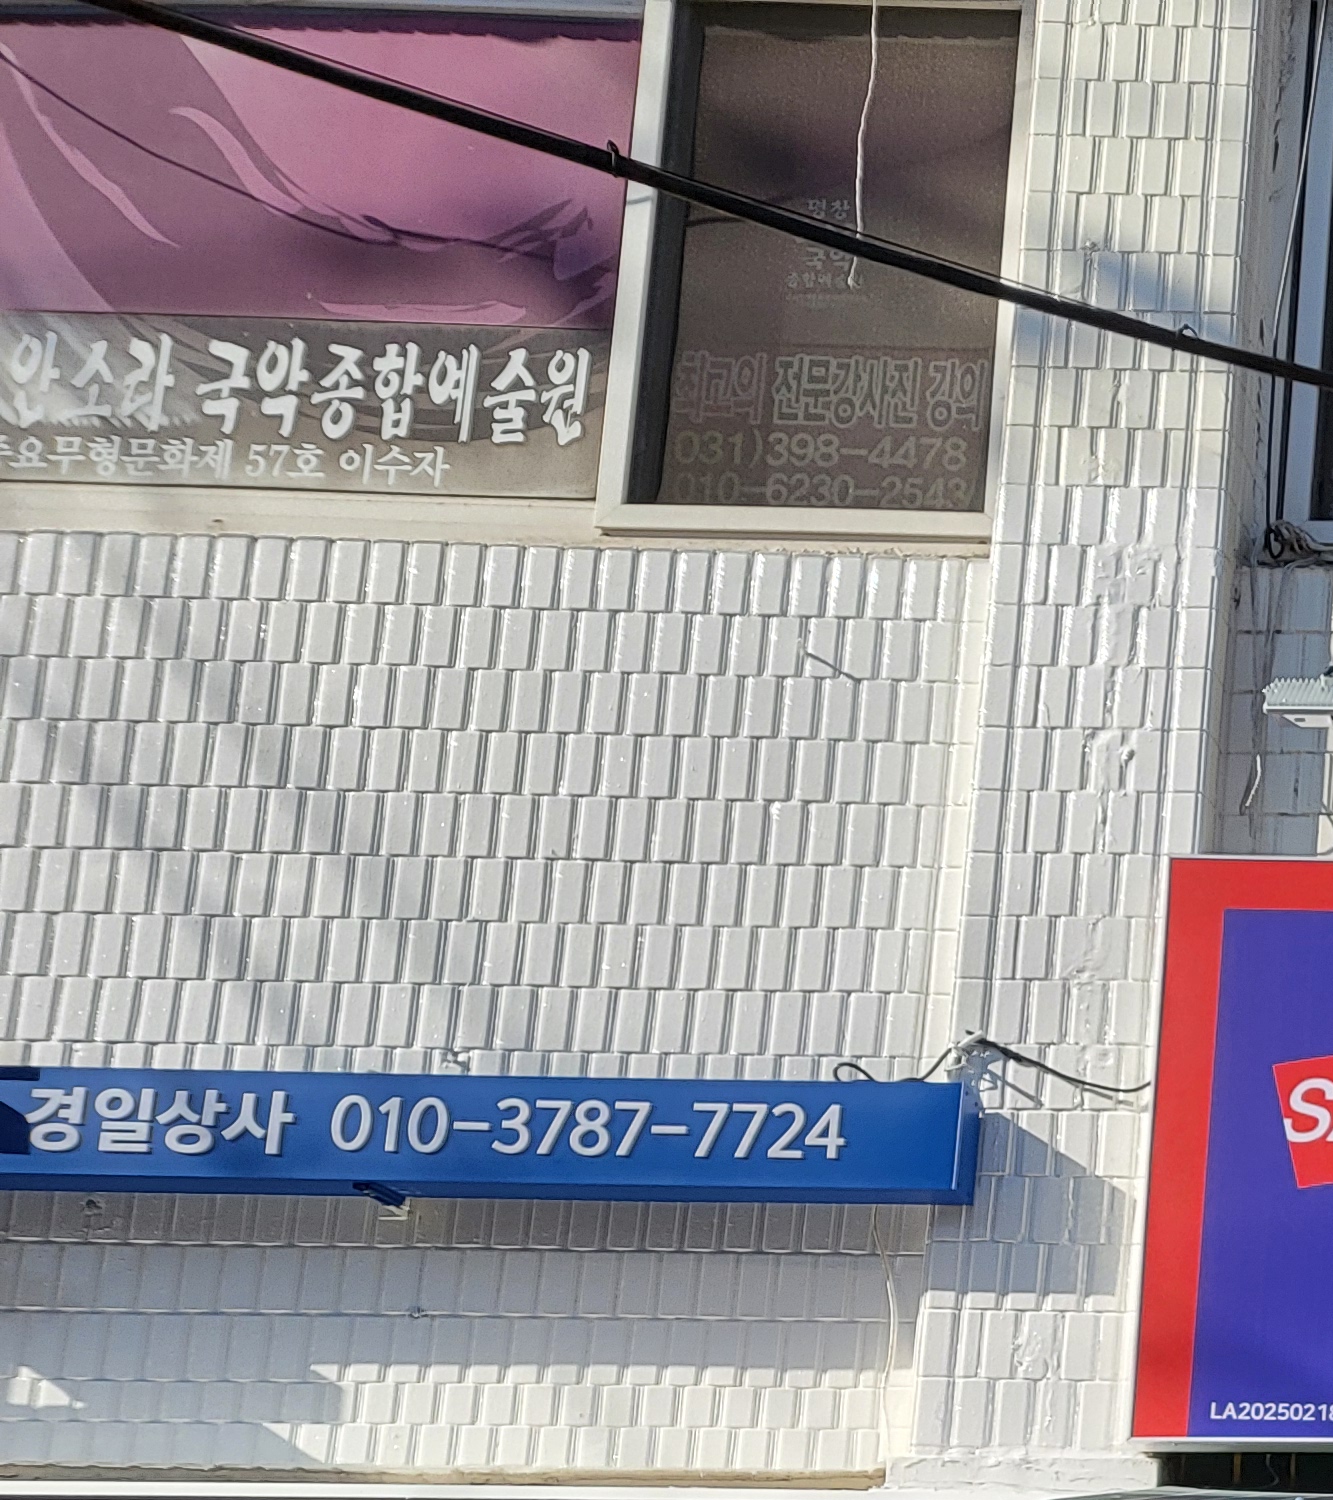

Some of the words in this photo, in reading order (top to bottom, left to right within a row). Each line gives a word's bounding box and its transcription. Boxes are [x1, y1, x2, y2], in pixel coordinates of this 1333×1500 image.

[196, 337, 592, 446] 국악종합예술원
[245, 445, 325, 480] 57호
[338, 444, 451, 487] 이수자
[26, 1086, 295, 1156] 경일상사
[330, 1094, 846, 1160] 010-3787-7724
